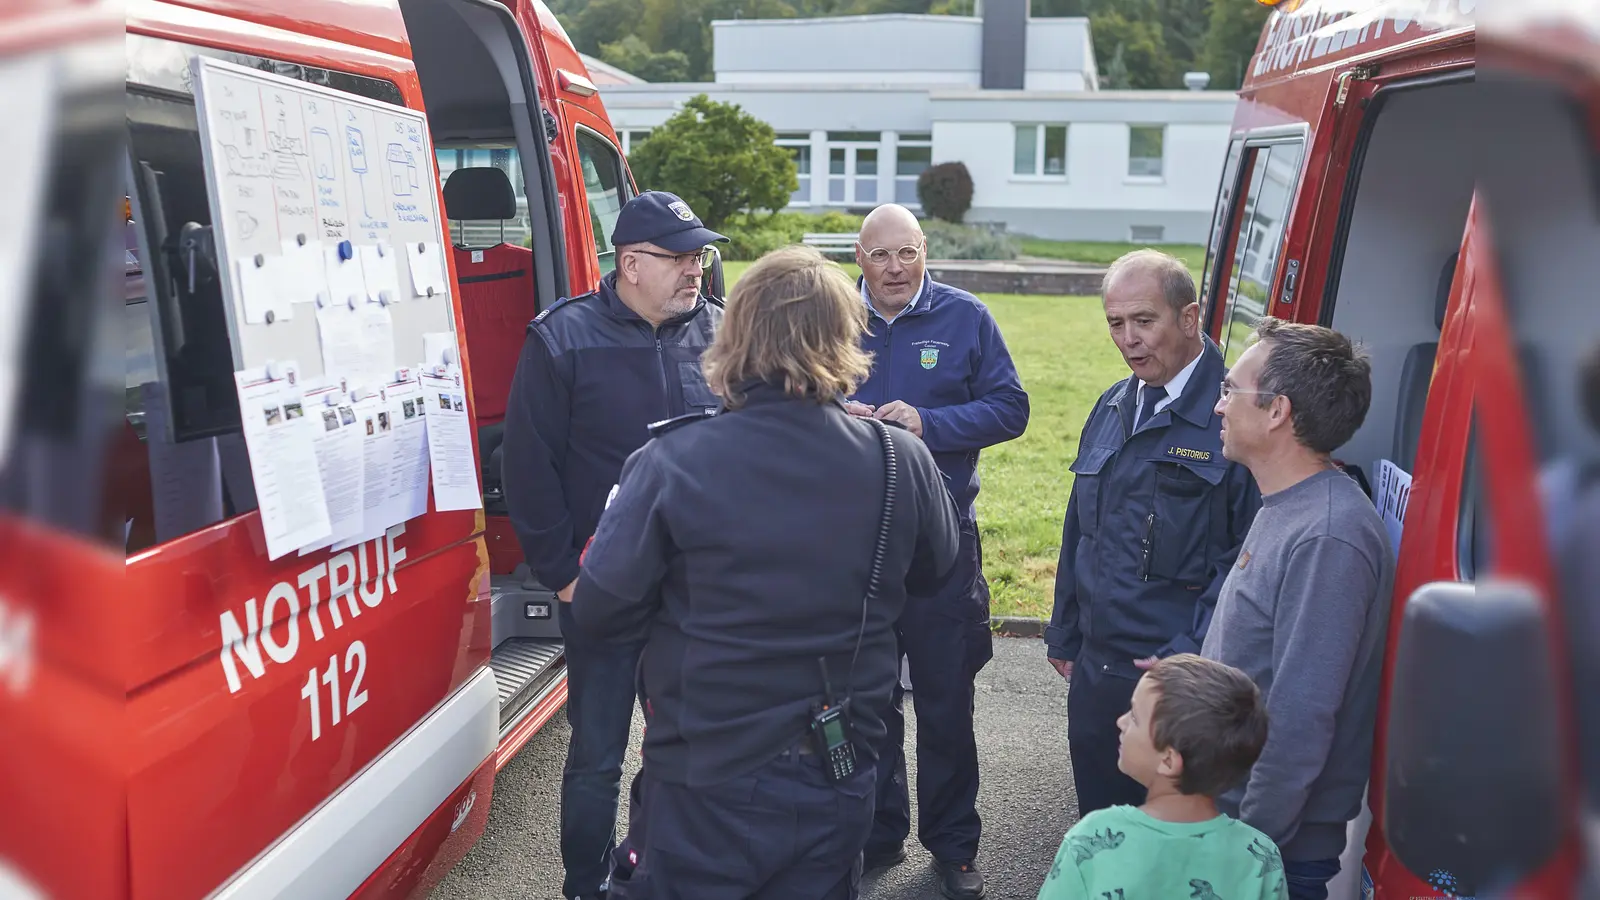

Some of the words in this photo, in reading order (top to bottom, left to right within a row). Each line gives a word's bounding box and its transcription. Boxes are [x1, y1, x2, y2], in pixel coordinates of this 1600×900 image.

[1167, 446, 1174, 455] J.
[1176, 447, 1211, 460] PISTORIUS
[219, 523, 407, 694] NOTRUF
[301, 640, 368, 742] 112
